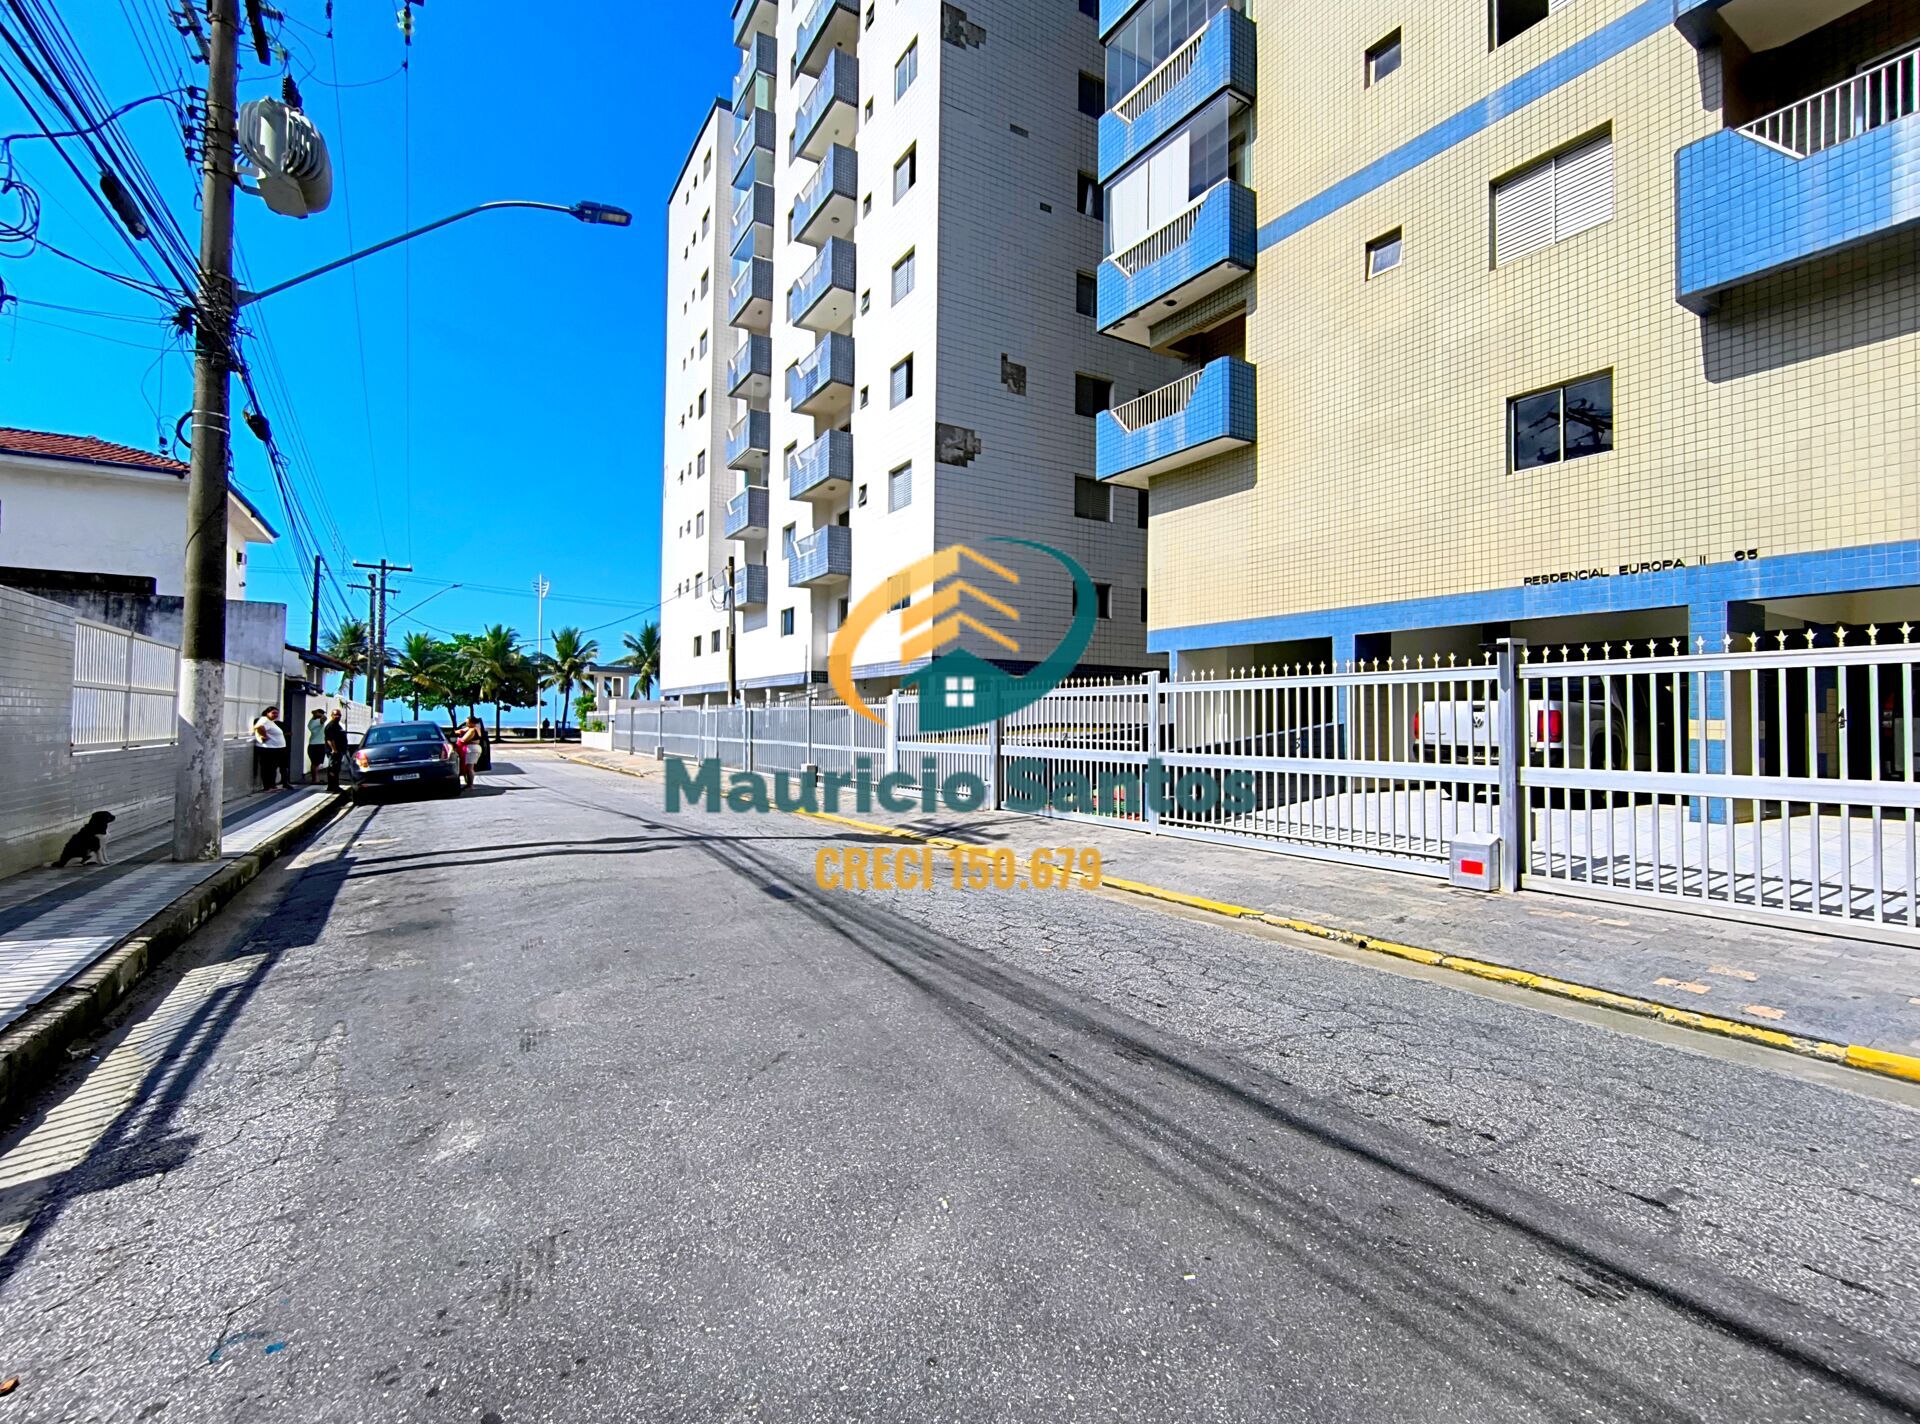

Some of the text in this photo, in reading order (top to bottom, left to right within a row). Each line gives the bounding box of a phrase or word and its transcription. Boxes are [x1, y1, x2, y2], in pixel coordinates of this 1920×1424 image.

[1734, 548, 1758, 561] 65
[1619, 558, 1686, 576] EUROPA
[1699, 555, 1706, 566] II
